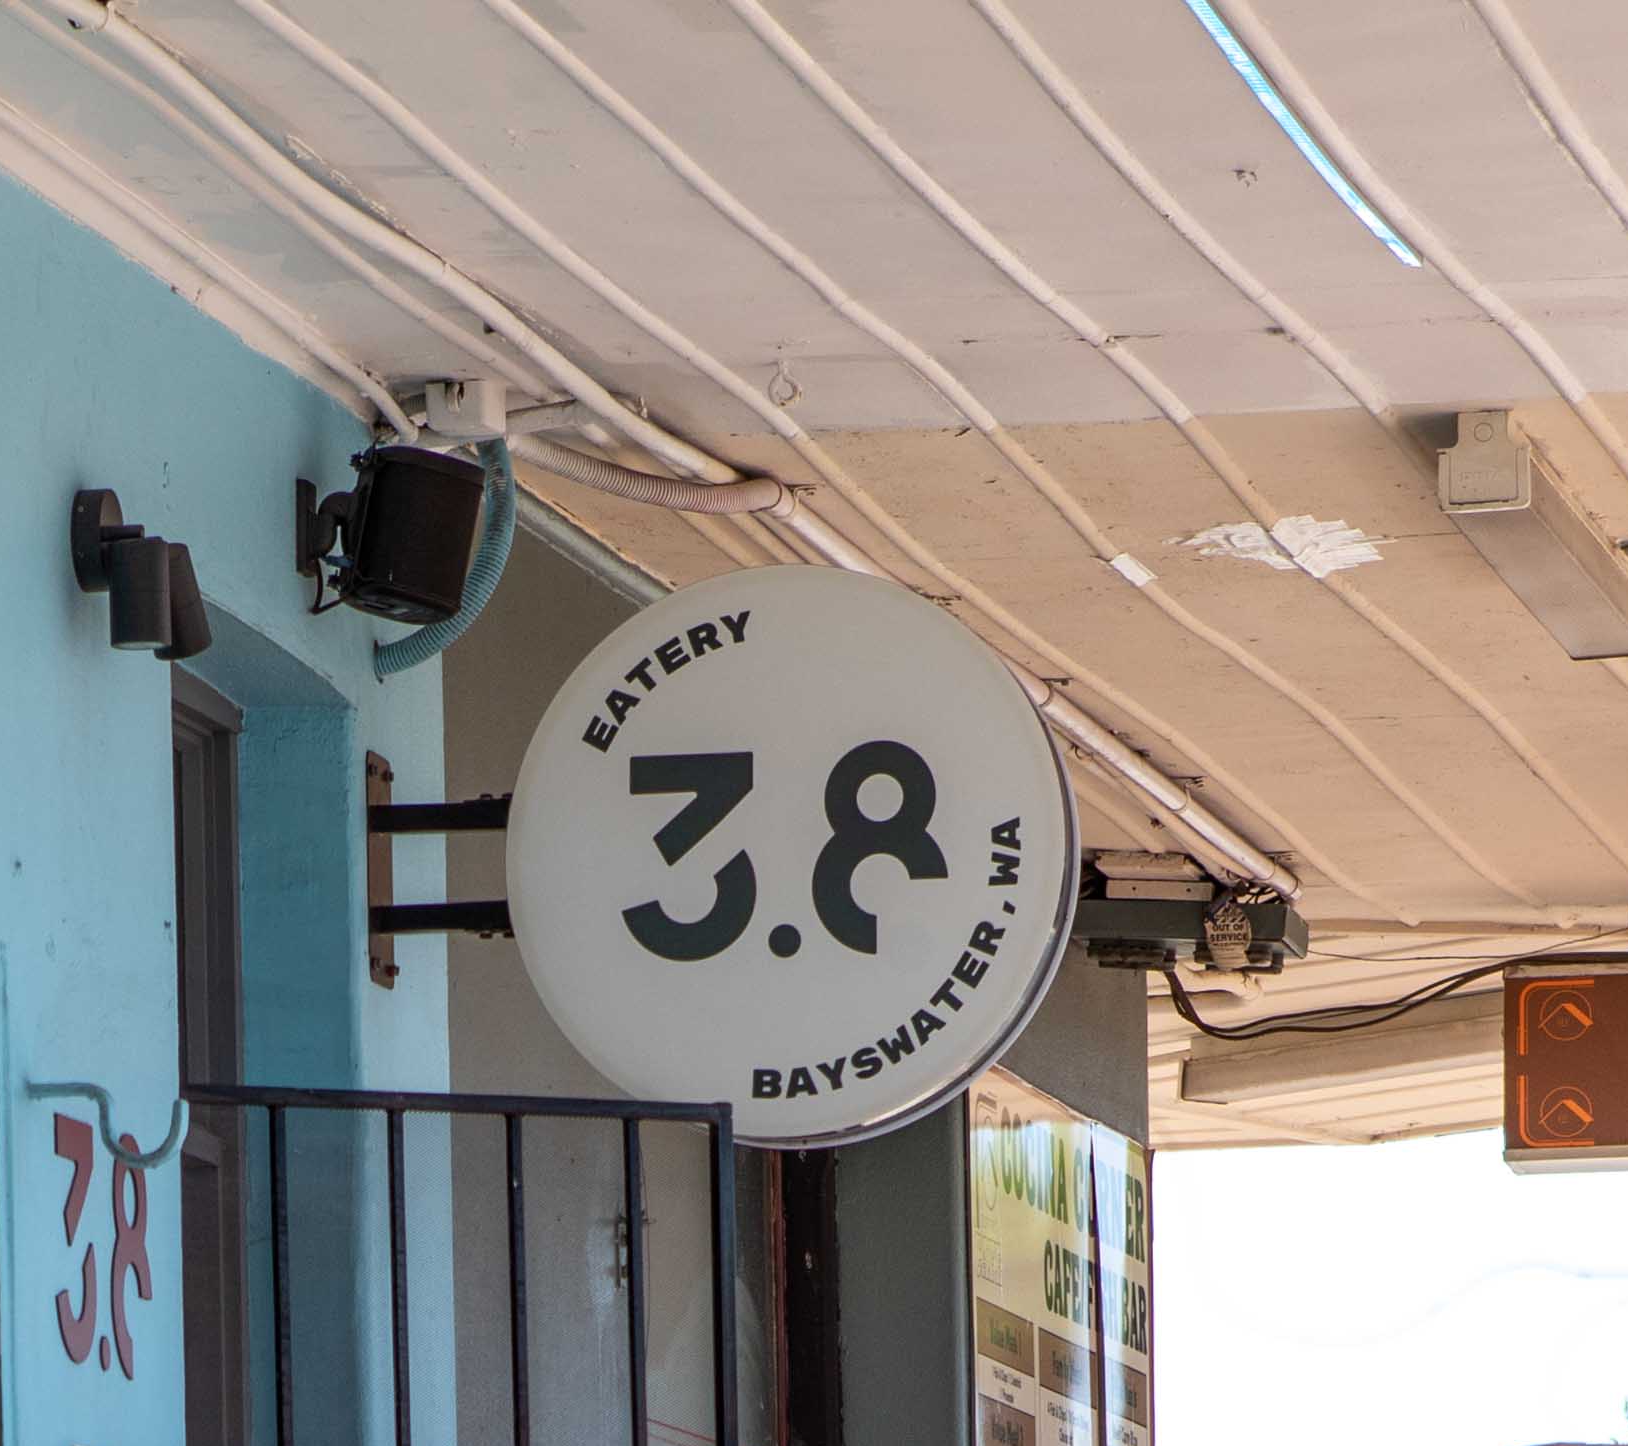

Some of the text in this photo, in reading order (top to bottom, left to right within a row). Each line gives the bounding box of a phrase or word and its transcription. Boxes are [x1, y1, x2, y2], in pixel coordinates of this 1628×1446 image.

[582, 611, 751, 753] EATERY
[621, 740, 949, 963] 3.8
[987, 816, 1021, 885] WA
